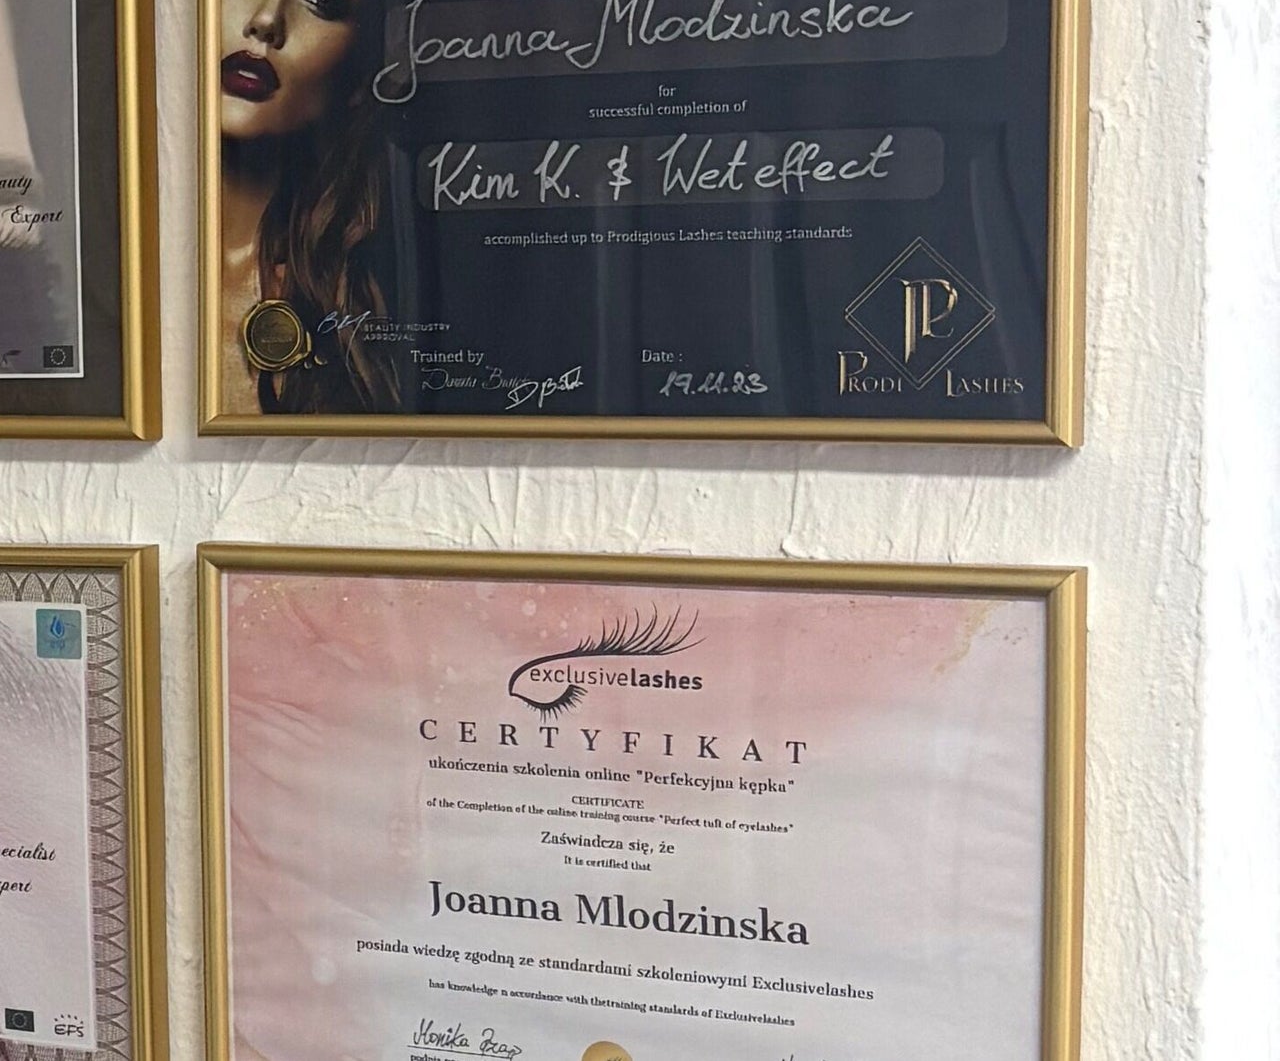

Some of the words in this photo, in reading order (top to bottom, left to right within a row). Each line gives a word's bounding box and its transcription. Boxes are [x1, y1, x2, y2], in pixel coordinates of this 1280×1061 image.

[428, 142, 520, 209] Kim
[538, 143, 581, 203] K.
[658, 134, 748, 193] Wet
[754, 134, 895, 195] effect
[484, 231, 569, 248] accomplished
[574, 232, 588, 246] up
[591, 231, 603, 244] to
[608, 229, 675, 245] Prodigious
[679, 228, 722, 242] Lashes
[727, 227, 781, 243] teaching
[785, 226, 853, 240] standards
[529, 663, 703, 693] exclusivelashes
[419, 719, 807, 764] CERTYFIKAT
[428, 757, 509, 776] ukończenia
[513, 764, 580, 781] szkolenia
[585, 768, 631, 783] online
[572, 795, 644, 810] CERTIFICATE
[428, 880, 562, 923] Joanna
[575, 893, 810, 947] Mlodzinska
